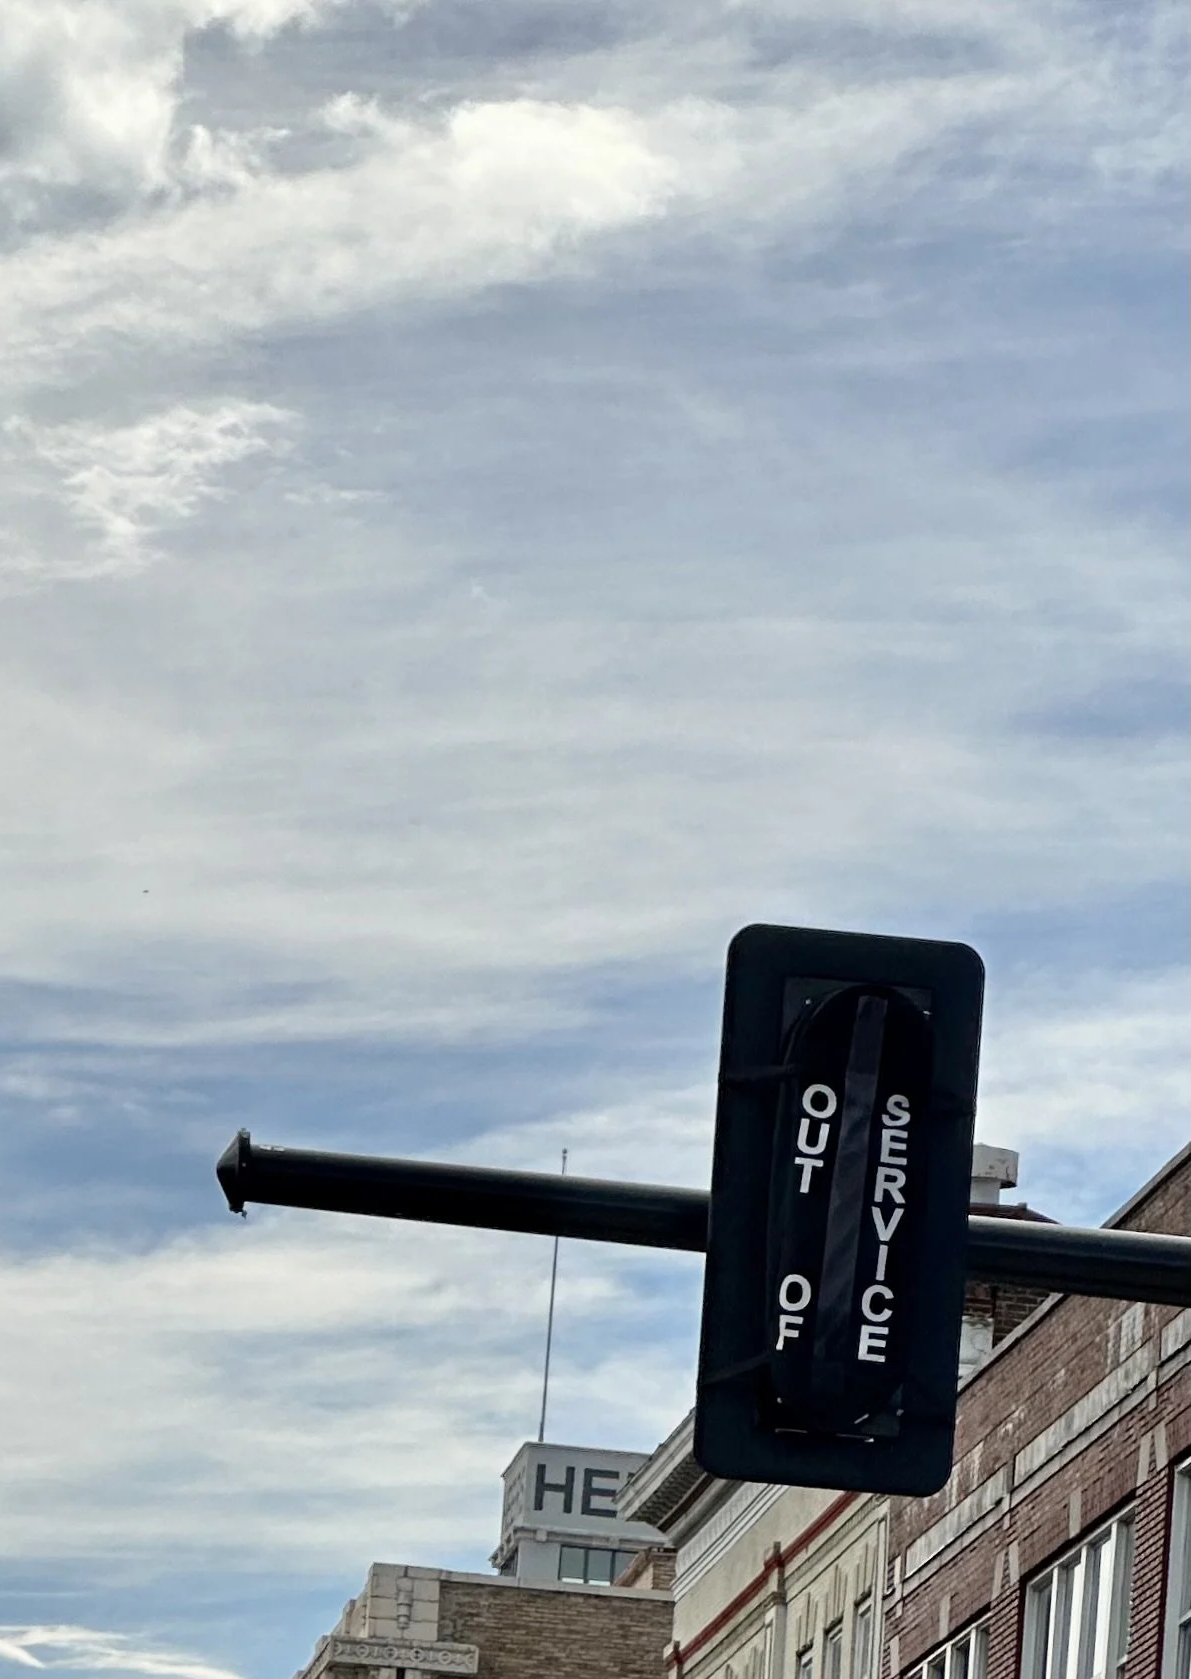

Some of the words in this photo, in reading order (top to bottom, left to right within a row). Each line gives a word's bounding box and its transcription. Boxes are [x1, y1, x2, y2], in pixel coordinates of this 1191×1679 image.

[794, 1083, 838, 1194] OUT
[857, 1093, 912, 1364] SERVICE
[774, 1273, 812, 1351] OF
[533, 1462, 634, 1519] HE
